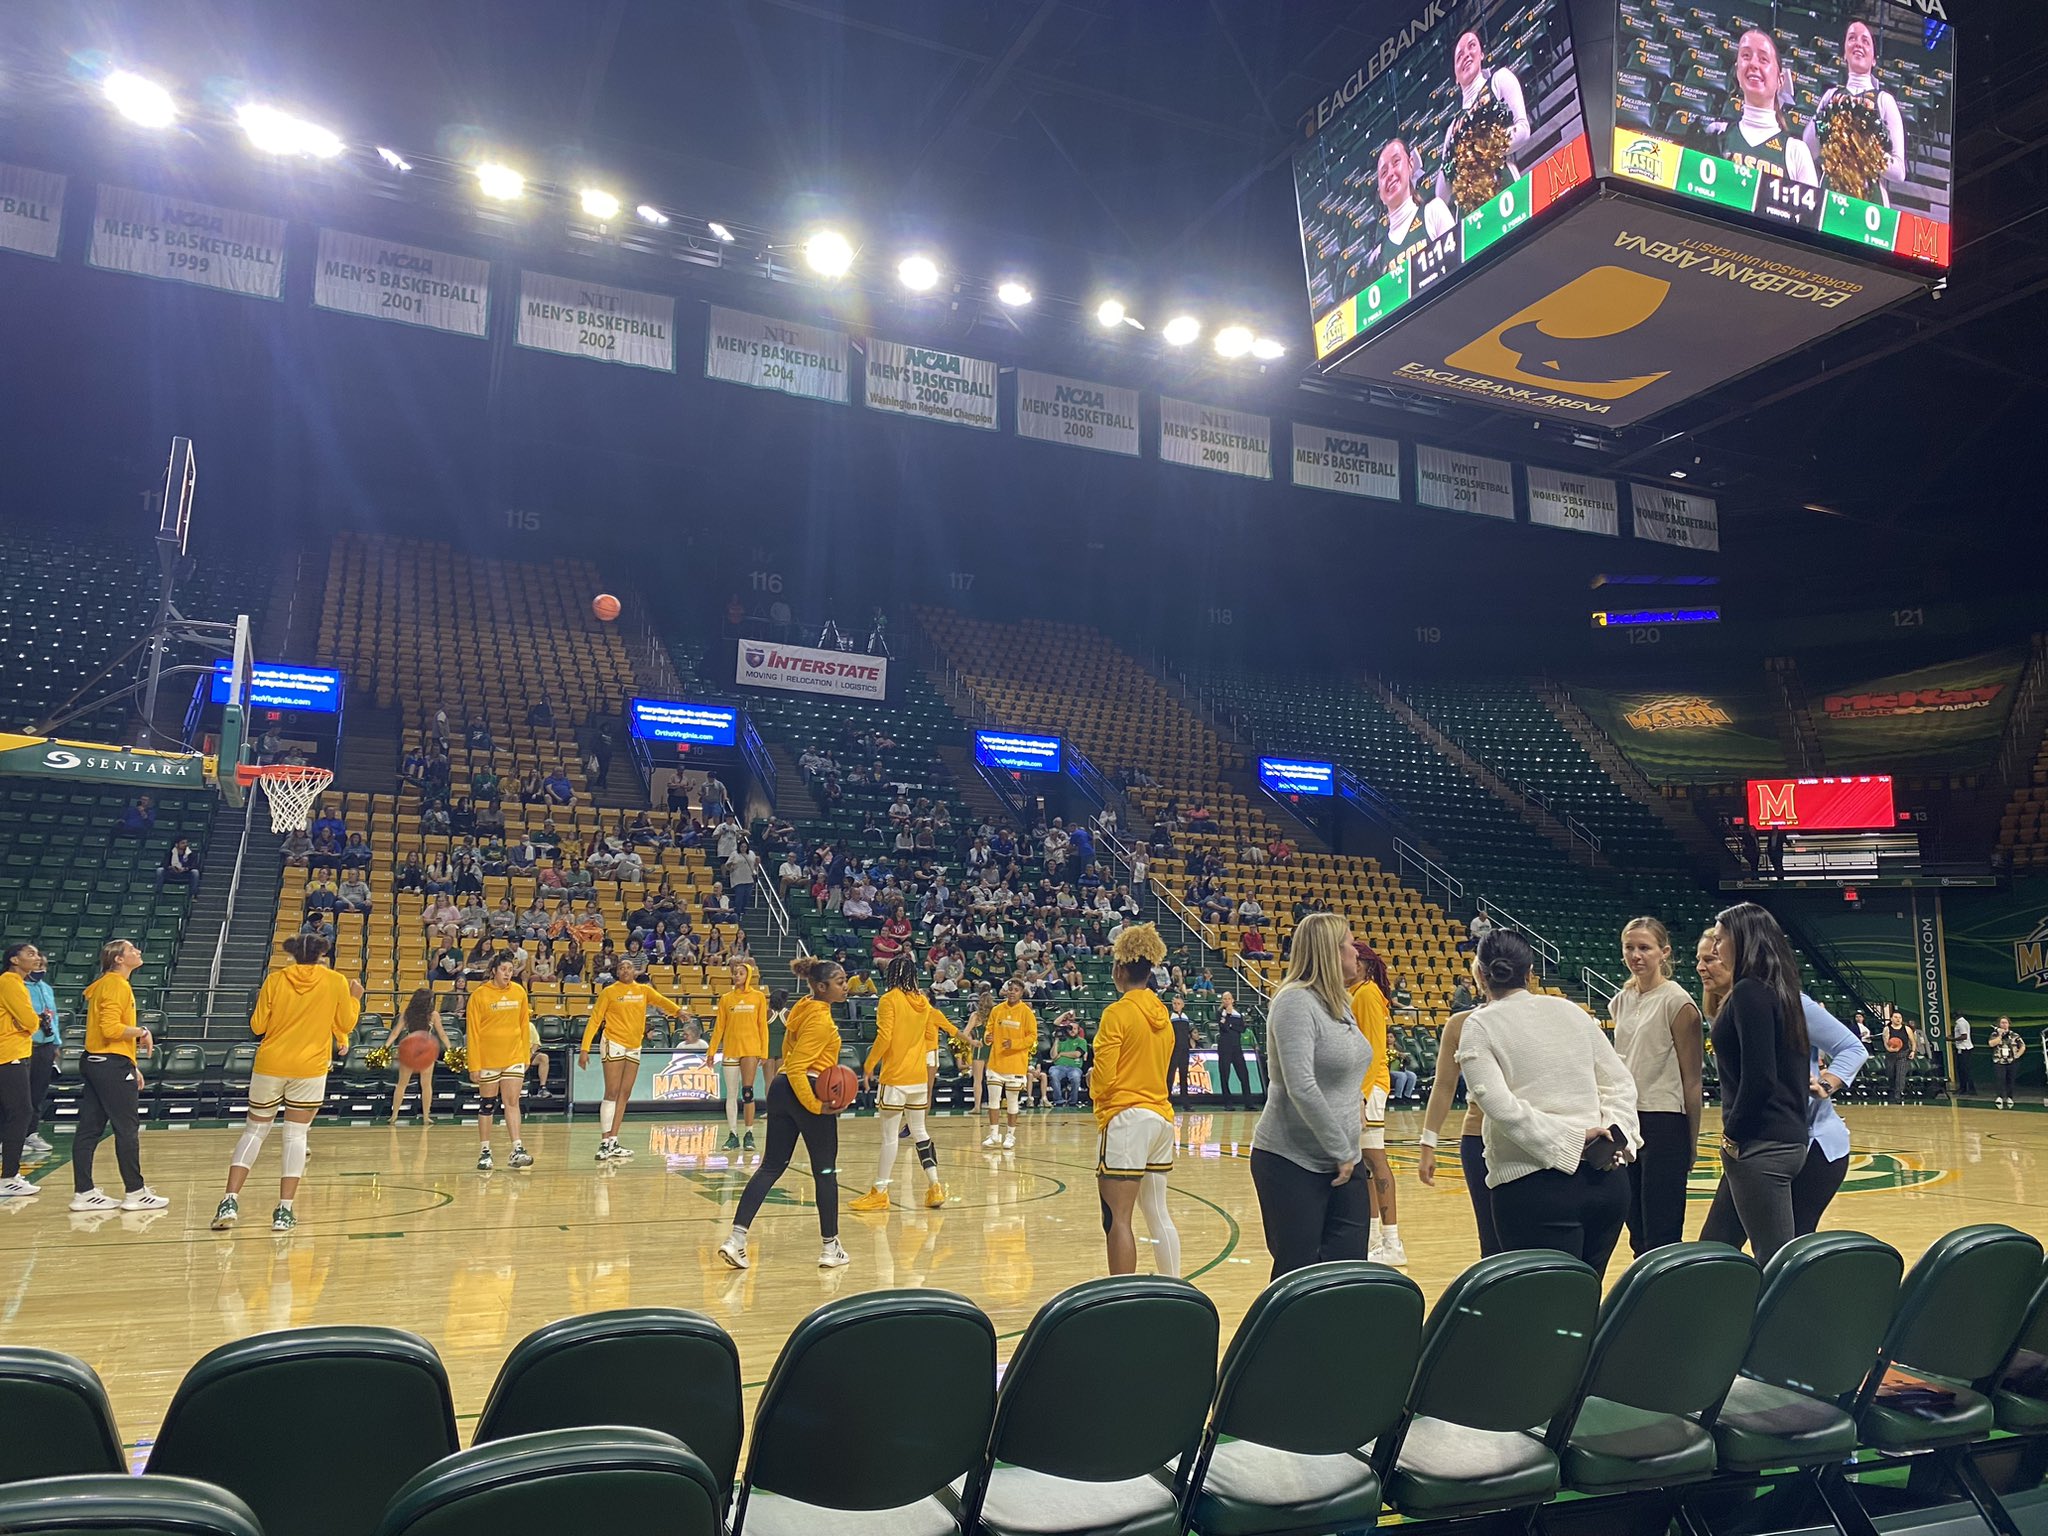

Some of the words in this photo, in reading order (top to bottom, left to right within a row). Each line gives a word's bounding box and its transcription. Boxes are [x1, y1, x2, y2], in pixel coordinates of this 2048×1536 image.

[1317, 0, 1446, 129] EAGLEBANK
[1700, 158, 1717, 185] 0
[1498, 190, 1515, 218] 0
[1769, 179, 1816, 211] 1:14
[0, 197, 49, 222] BALL
[1864, 205, 1881, 231] 0
[103, 219, 160, 242] MEN'S
[164, 230, 275, 265] BASKETBALL
[1417, 233, 1457, 272] 1:14
[1613, 231, 1712, 269] ARENA
[1678, 238, 1760, 266] UNIVERSITY
[167, 251, 209, 272] 1999
[377, 250, 433, 275] NCAA
[1760, 260, 1810, 278] MASON
[324, 261, 377, 283] MEN'S
[380, 271, 479, 304] BASKETBALL
[1700, 255, 1852, 309] EAGLEBANK
[1807, 273, 1864, 293] GEORGE
[381, 292, 423, 313] 2001
[1368, 285, 1381, 309] 0
[528, 302, 574, 323] MEN'S
[577, 310, 665, 339] BASKETBALL
[579, 330, 616, 350] 2002
[763, 325, 799, 346] NIT
[716, 335, 759, 357] MEN'S
[761, 343, 843, 373] BASKETBALL
[905, 348, 960, 375] NCAA
[763, 363, 795, 384] 2004
[870, 361, 911, 384] MEN'S
[912, 370, 993, 398] BASKETBALL
[915, 386, 949, 405] 2006
[1055, 385, 1105, 410] NCAA
[1399, 362, 1538, 399] EAGLEBANK
[1534, 394, 1611, 414] ARENA
[869, 392, 917, 411] Washington
[918, 401, 953, 418] Regional
[953, 408, 993, 425] Champion
[1022, 397, 1060, 417] MEN'S
[1061, 404, 1135, 430] BASKETBALL
[1200, 411, 1232, 430] NIT
[1064, 421, 1094, 439] 2008
[1163, 422, 1199, 441] MEN'S
[1200, 429, 1268, 453] BASKETBALL
[1202, 448, 1230, 464] 2009
[1324, 437, 1369, 459] NCAA
[1296, 448, 1330, 467] MEN'S
[1331, 455, 1396, 477] BASKETBALL
[1334, 470, 1360, 486] 2011
[505, 510, 541, 531] 115
[749, 571, 784, 593] 116
[948, 572, 976, 590] 117
[1891, 608, 1925, 627] 121
[1415, 627, 1441, 643] 119
[1626, 627, 1661, 644] 120
[767, 651, 880, 681] INTERSTATE
[745, 670, 778, 681] MOVING
[786, 675, 832, 687] RELOCATION
[841, 682, 878, 692] LOGISTICS
[1626, 705, 1728, 728] MASON
[1938, 700, 1990, 712] FAIRFAX
[692, 746, 704, 756] 10
[86, 757, 188, 776] SENTARA
[1757, 784, 1798, 820] M
[1915, 812, 1928, 822] 13
[1924, 917, 1942, 1039] GOMASON.COM
[655, 1074, 719, 1098] MASON
[668, 1091, 707, 1099] PATRIOTS
